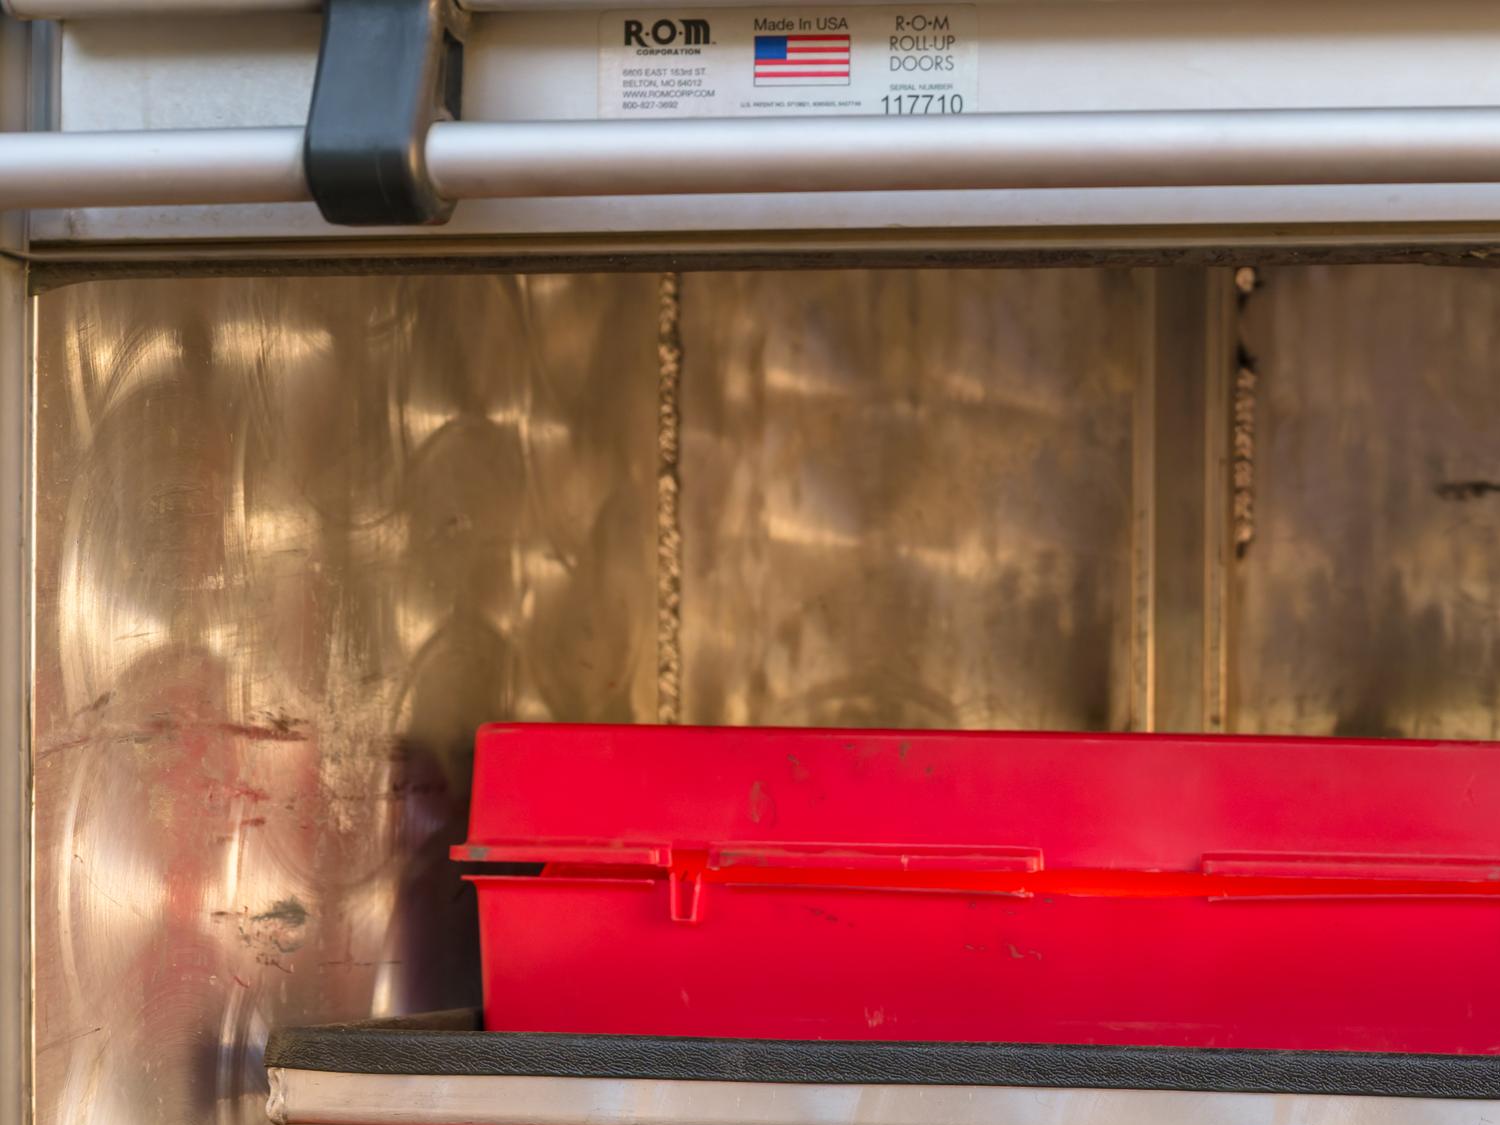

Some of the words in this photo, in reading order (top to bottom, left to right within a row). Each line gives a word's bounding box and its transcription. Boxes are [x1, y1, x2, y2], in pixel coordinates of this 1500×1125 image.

[754, 17, 794, 31] Made
[799, 18, 812, 31] In
[816, 17, 849, 31] USA
[889, 35, 956, 52] ROLL-UP
[636, 48, 702, 56] CORPORATION
[890, 55, 954, 72] DOORS
[644, 68, 667, 77] EAST
[661, 79, 675, 87] MO
[881, 94, 963, 115] 117710
